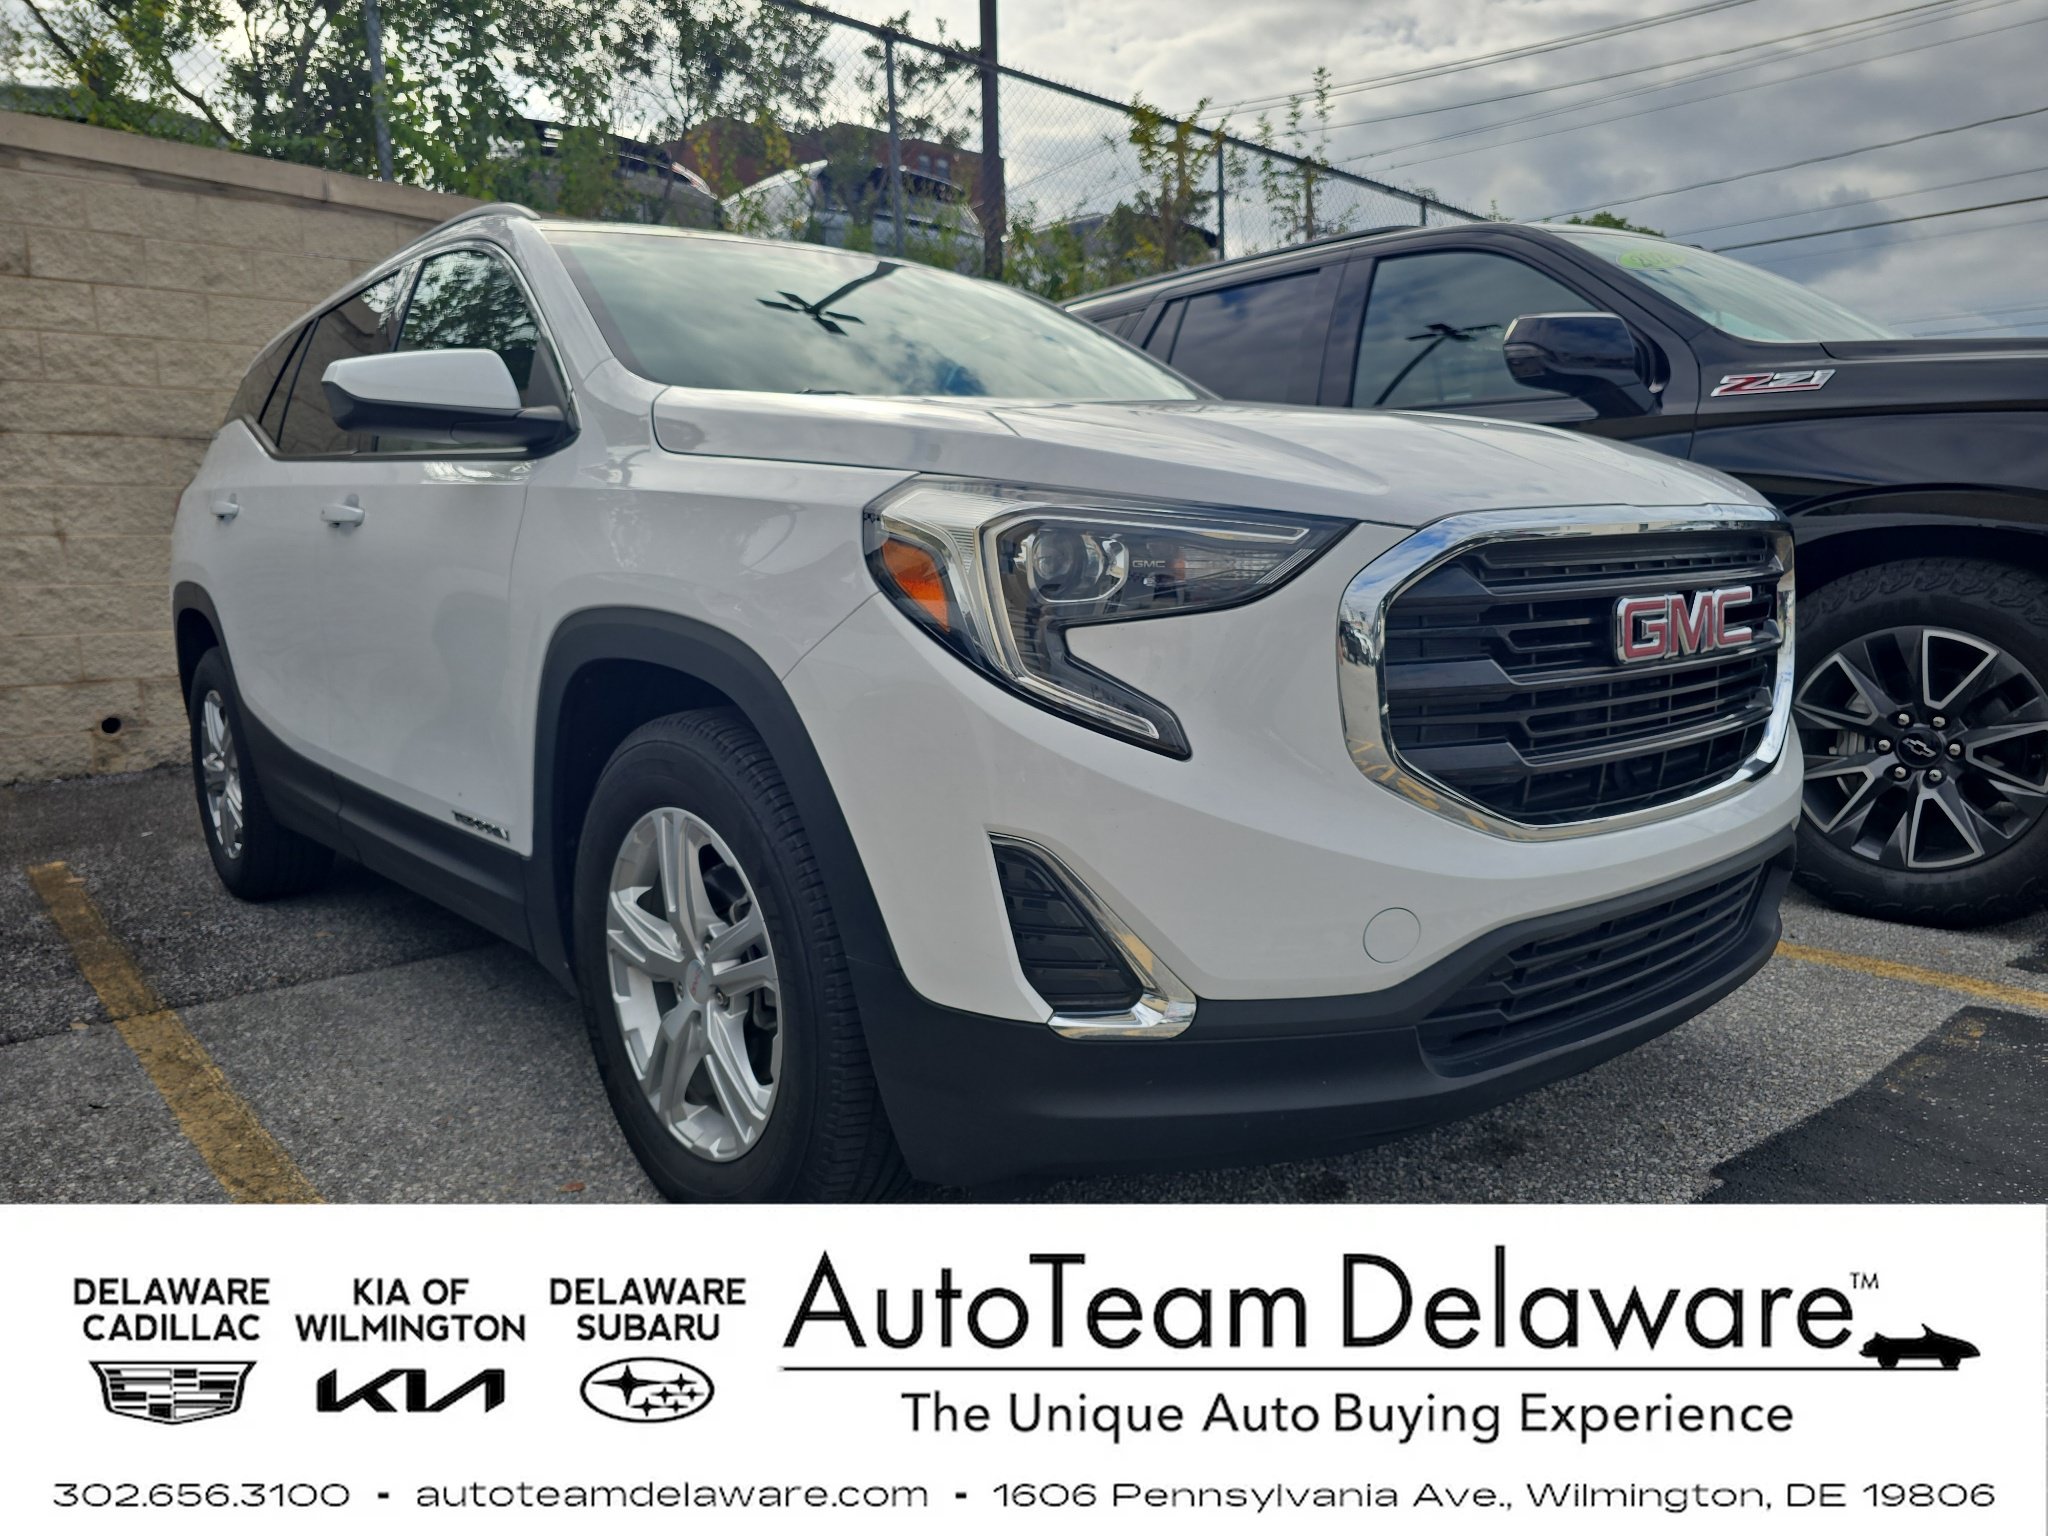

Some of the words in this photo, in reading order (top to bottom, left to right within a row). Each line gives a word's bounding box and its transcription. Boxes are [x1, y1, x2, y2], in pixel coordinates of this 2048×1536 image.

[1710, 368, 1837, 398] Z71
[1132, 559, 1166, 569] GMC
[1615, 585, 1753, 664] GMC
